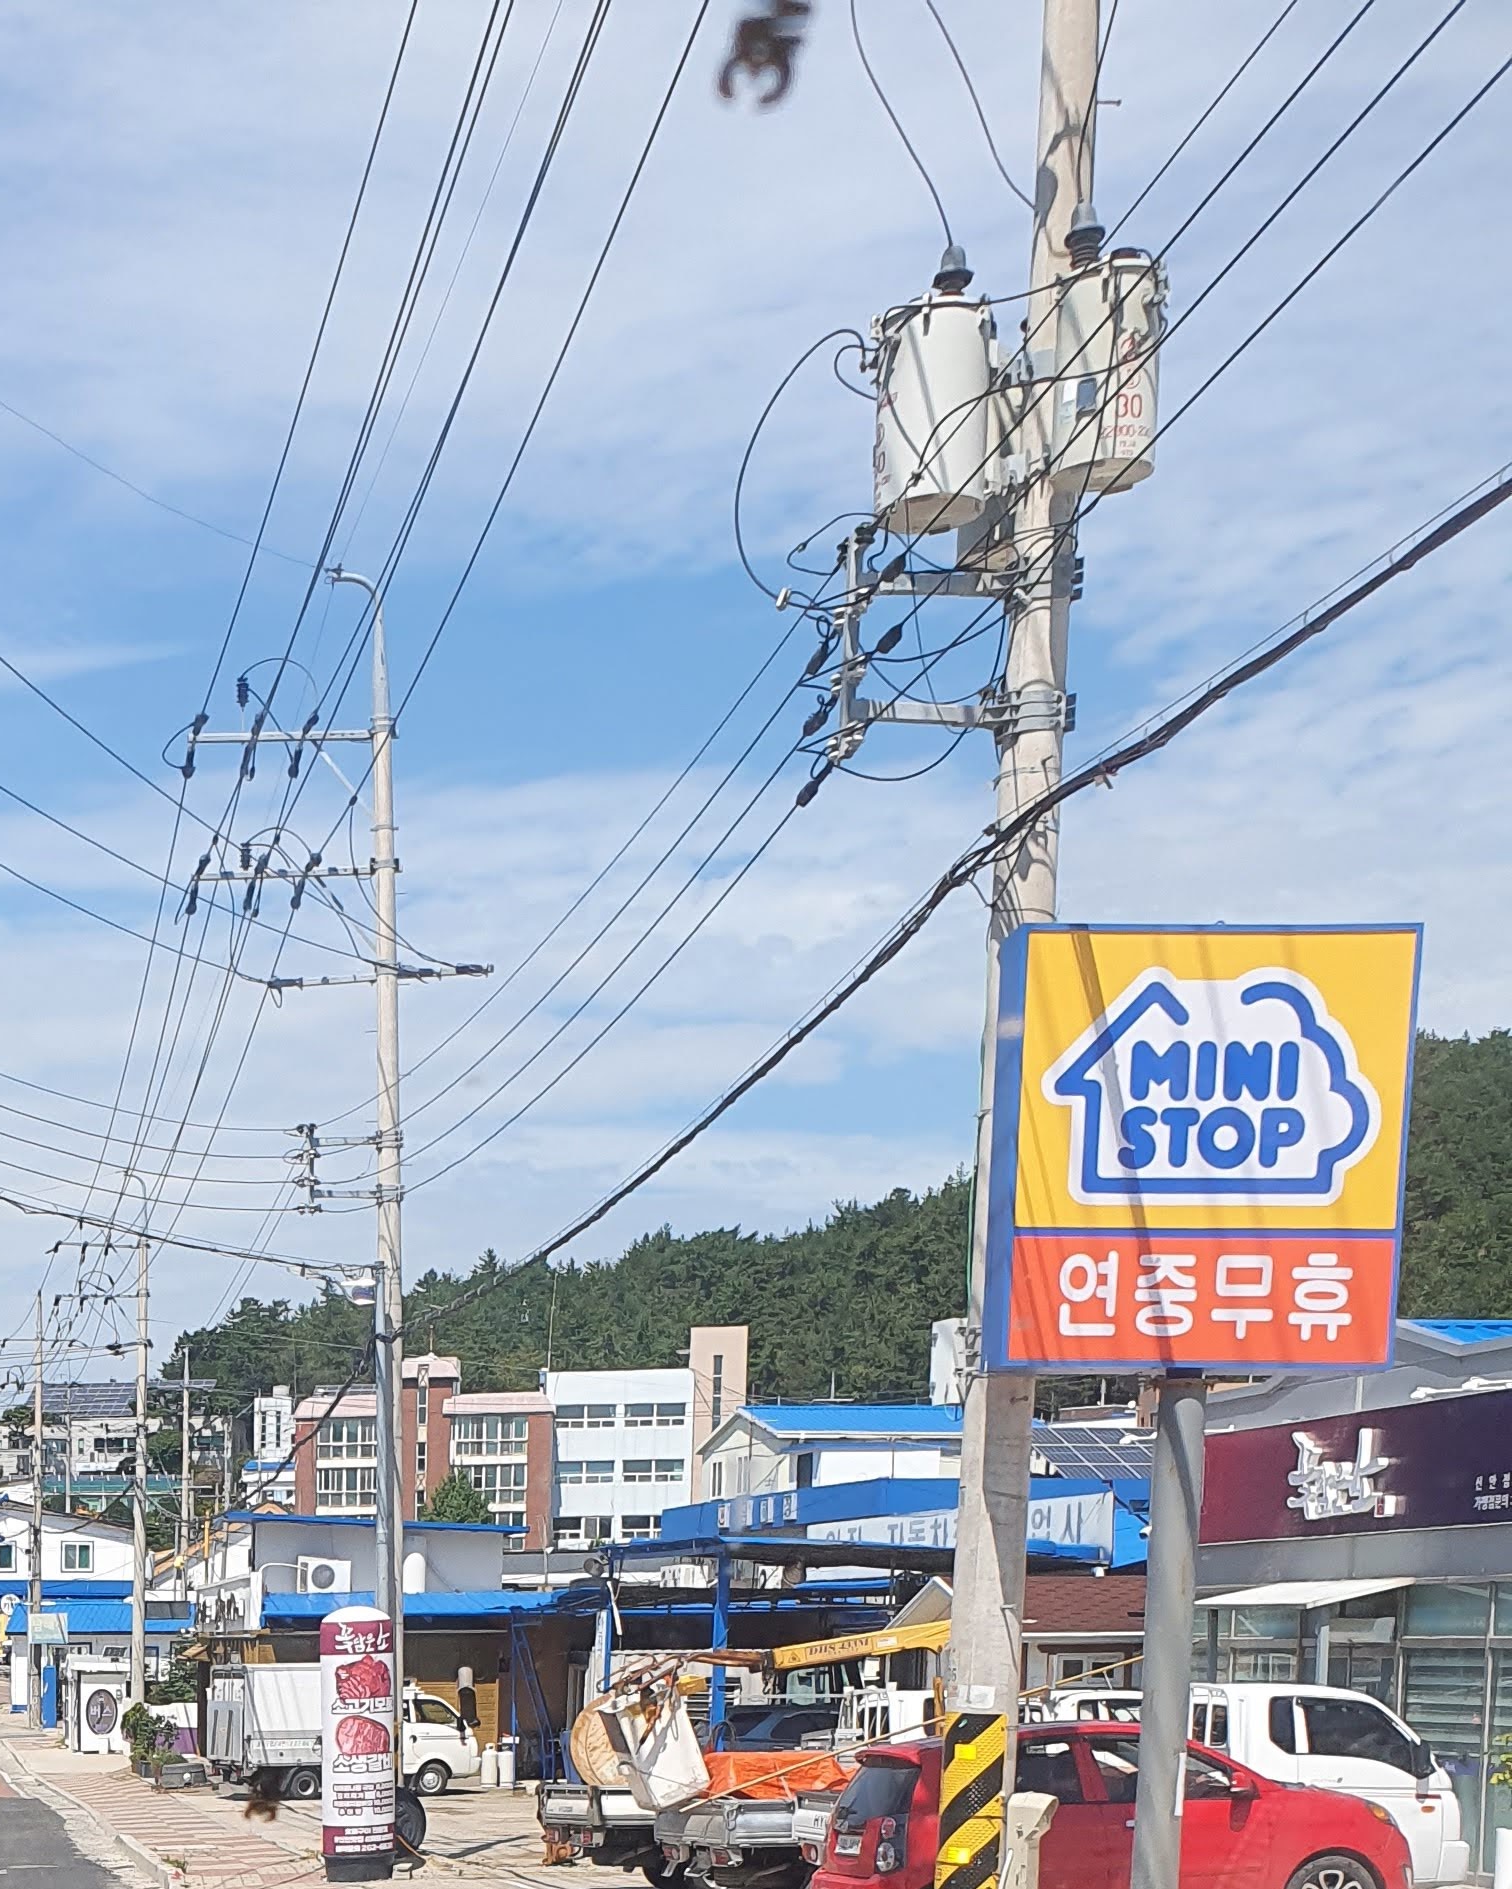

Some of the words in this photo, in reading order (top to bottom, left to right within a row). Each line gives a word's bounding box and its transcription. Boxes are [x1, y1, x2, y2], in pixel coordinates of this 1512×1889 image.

[1129, 1040, 1299, 1101] MINI
[1117, 1107, 1305, 1170] STOP
[1058, 1251, 1354, 1342] 연중무휴
[90, 1707, 113, 1718] 버스
